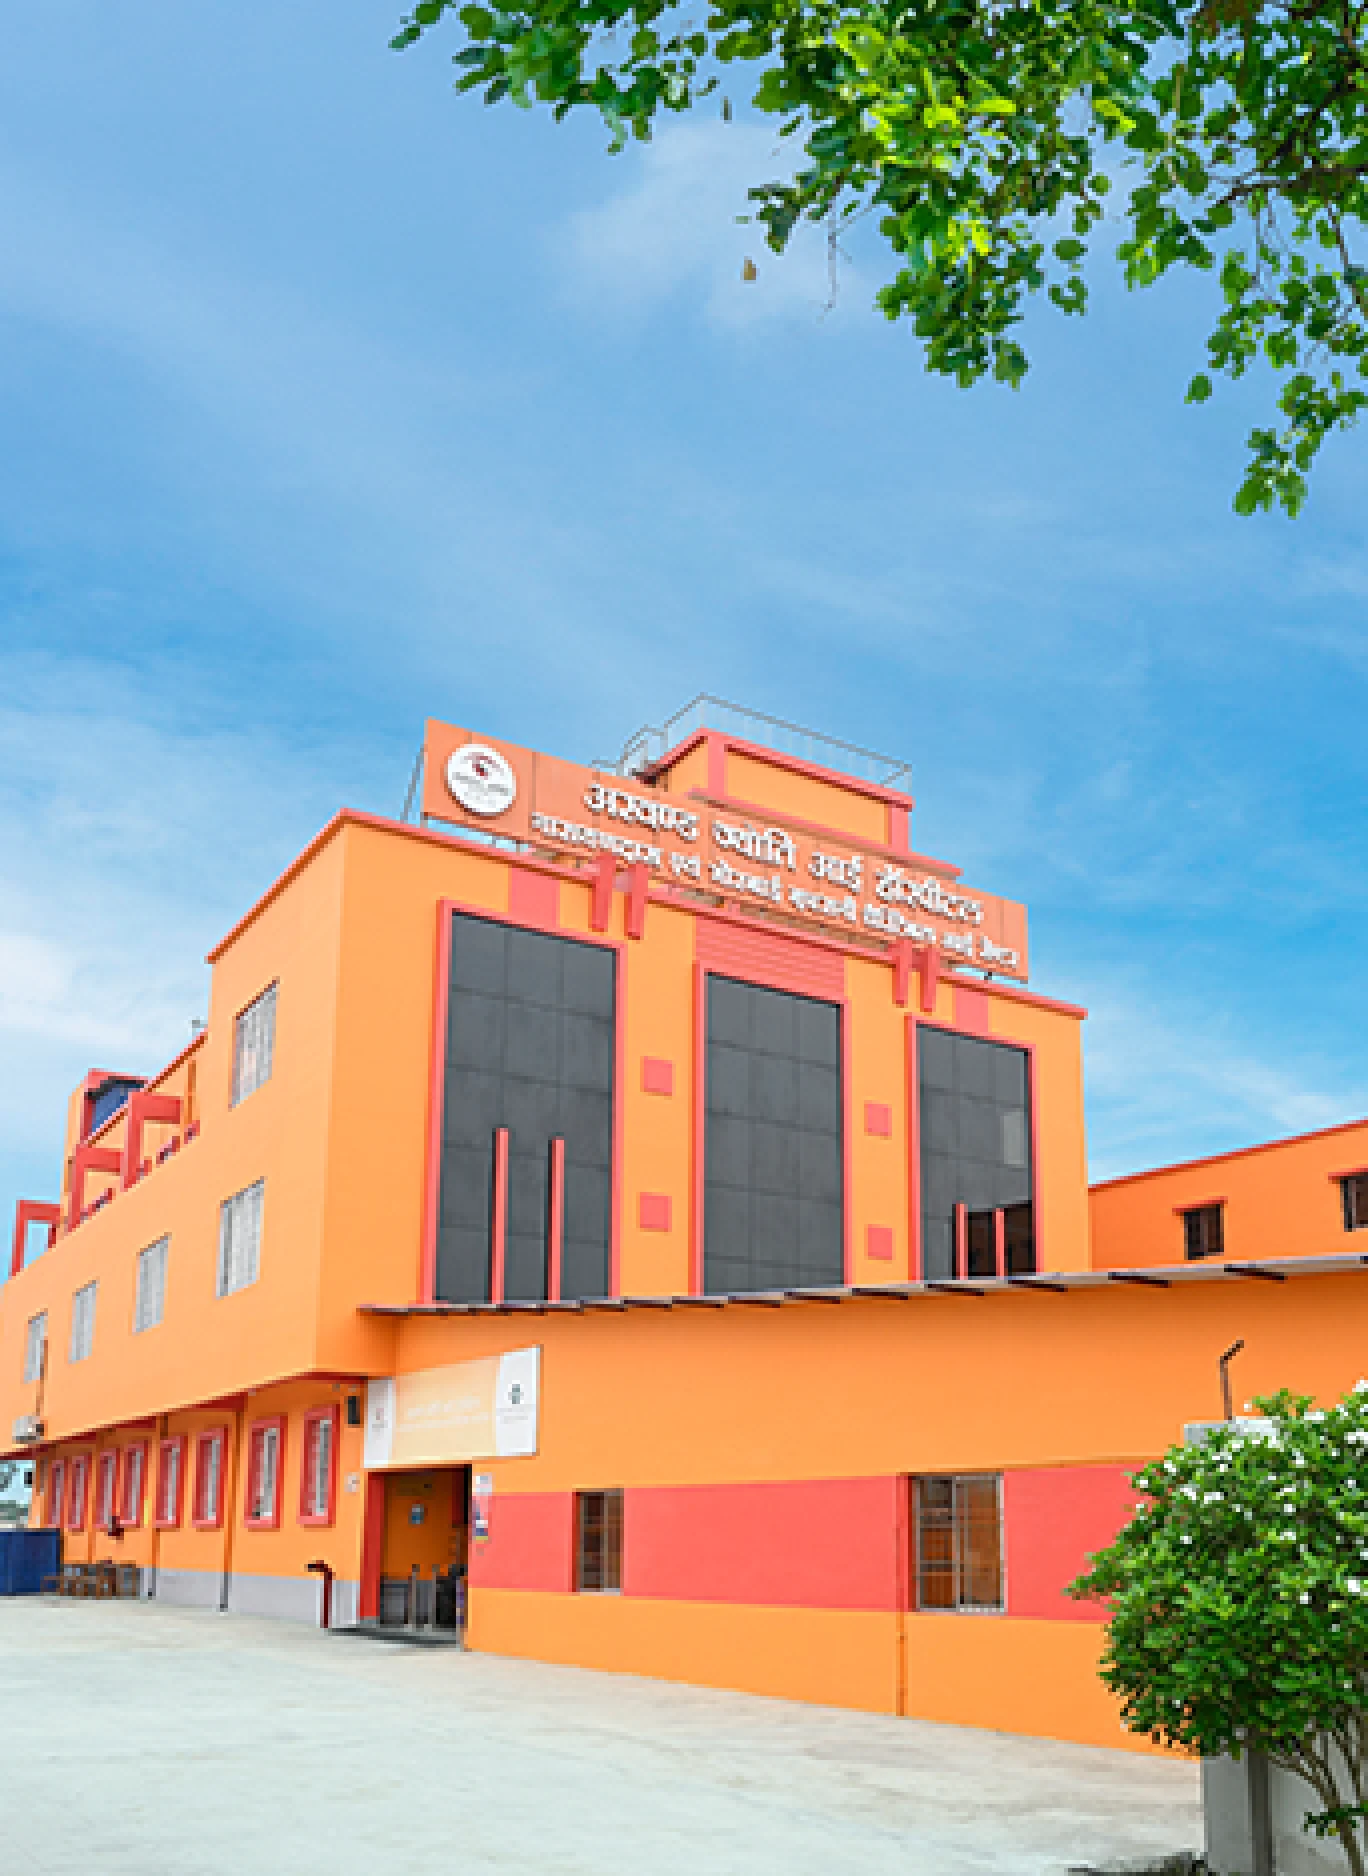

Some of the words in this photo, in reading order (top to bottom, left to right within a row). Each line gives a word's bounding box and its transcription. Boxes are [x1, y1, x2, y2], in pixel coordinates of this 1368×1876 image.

[584, 782, 700, 840] अखण्ड
[714, 812, 796, 870] ज्योति
[808, 852, 865, 892] आई
